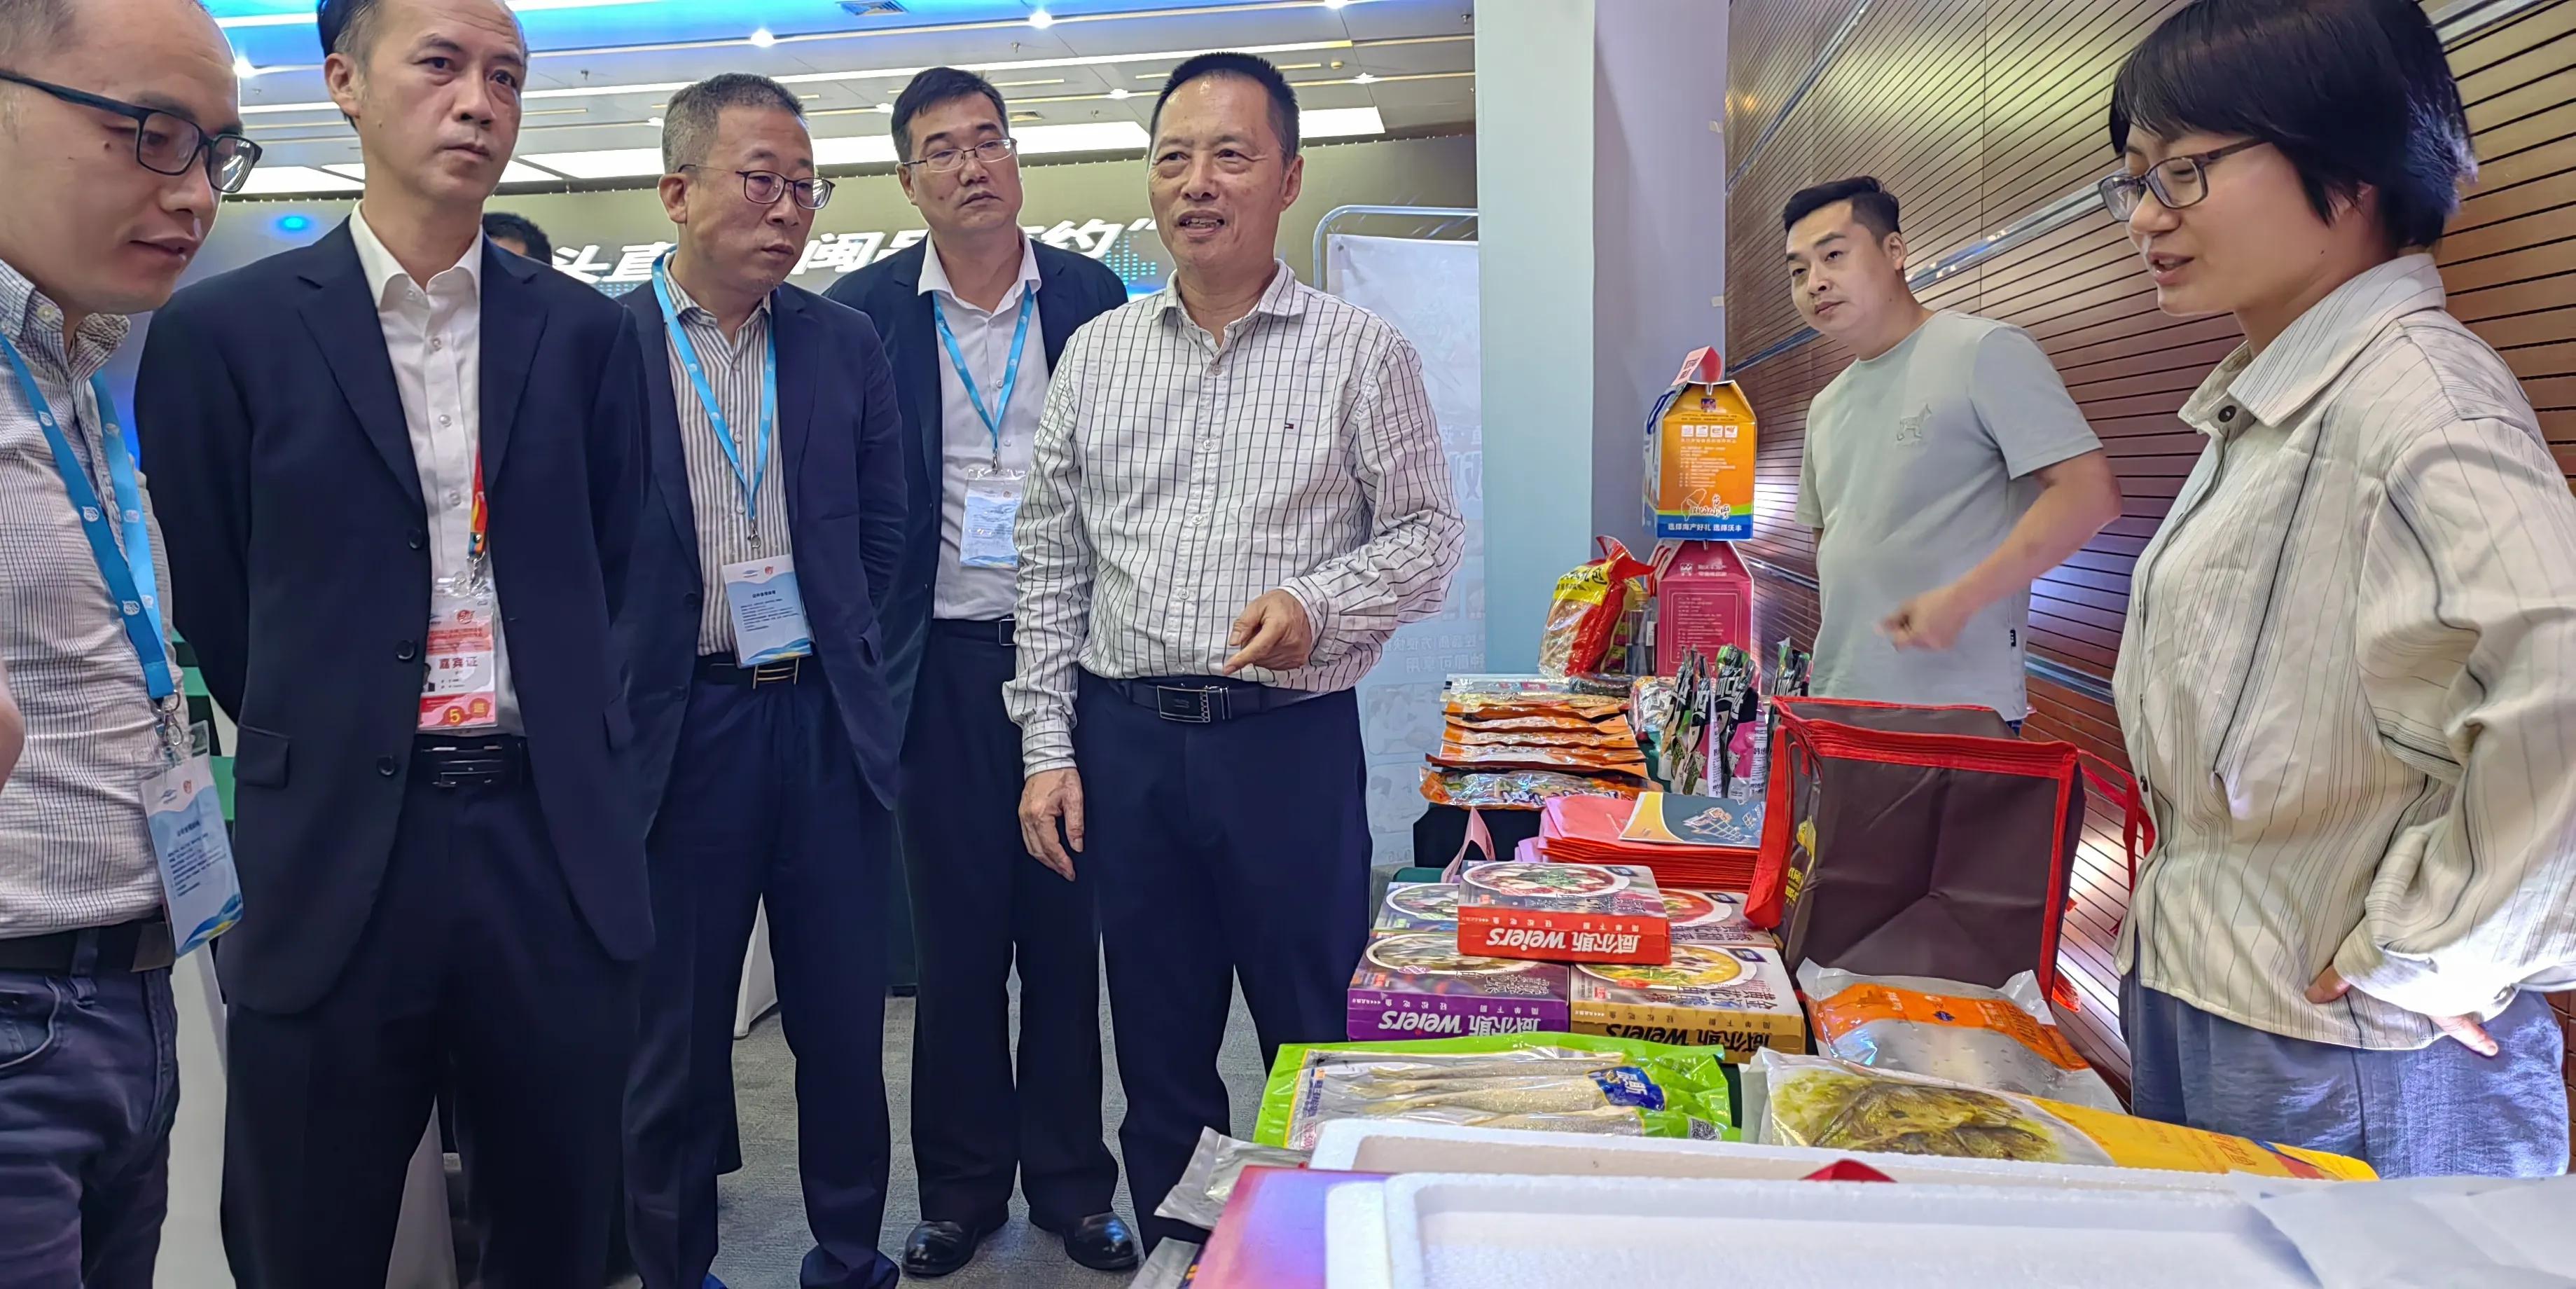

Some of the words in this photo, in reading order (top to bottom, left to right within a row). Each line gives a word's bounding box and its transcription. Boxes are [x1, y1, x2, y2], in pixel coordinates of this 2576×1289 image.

[440, 656, 478, 669] 嘉宾证
[450, 709, 460, 722] 5
[1486, 927, 1566, 951] weiers
[1571, 931, 1641, 954] 威尔斯
[1677, 985, 1777, 1000] 黄花鱼
[1385, 998, 1448, 1011] 轻松吃鱼
[1479, 1004, 1539, 1015] 简单下厨
[1378, 1011, 1462, 1035] weiers
[1609, 1011, 1675, 1023] 轻松吃鱼
[1709, 1017, 1771, 1029] 简单下厨
[1468, 1014, 1542, 1037] 威尔斯
